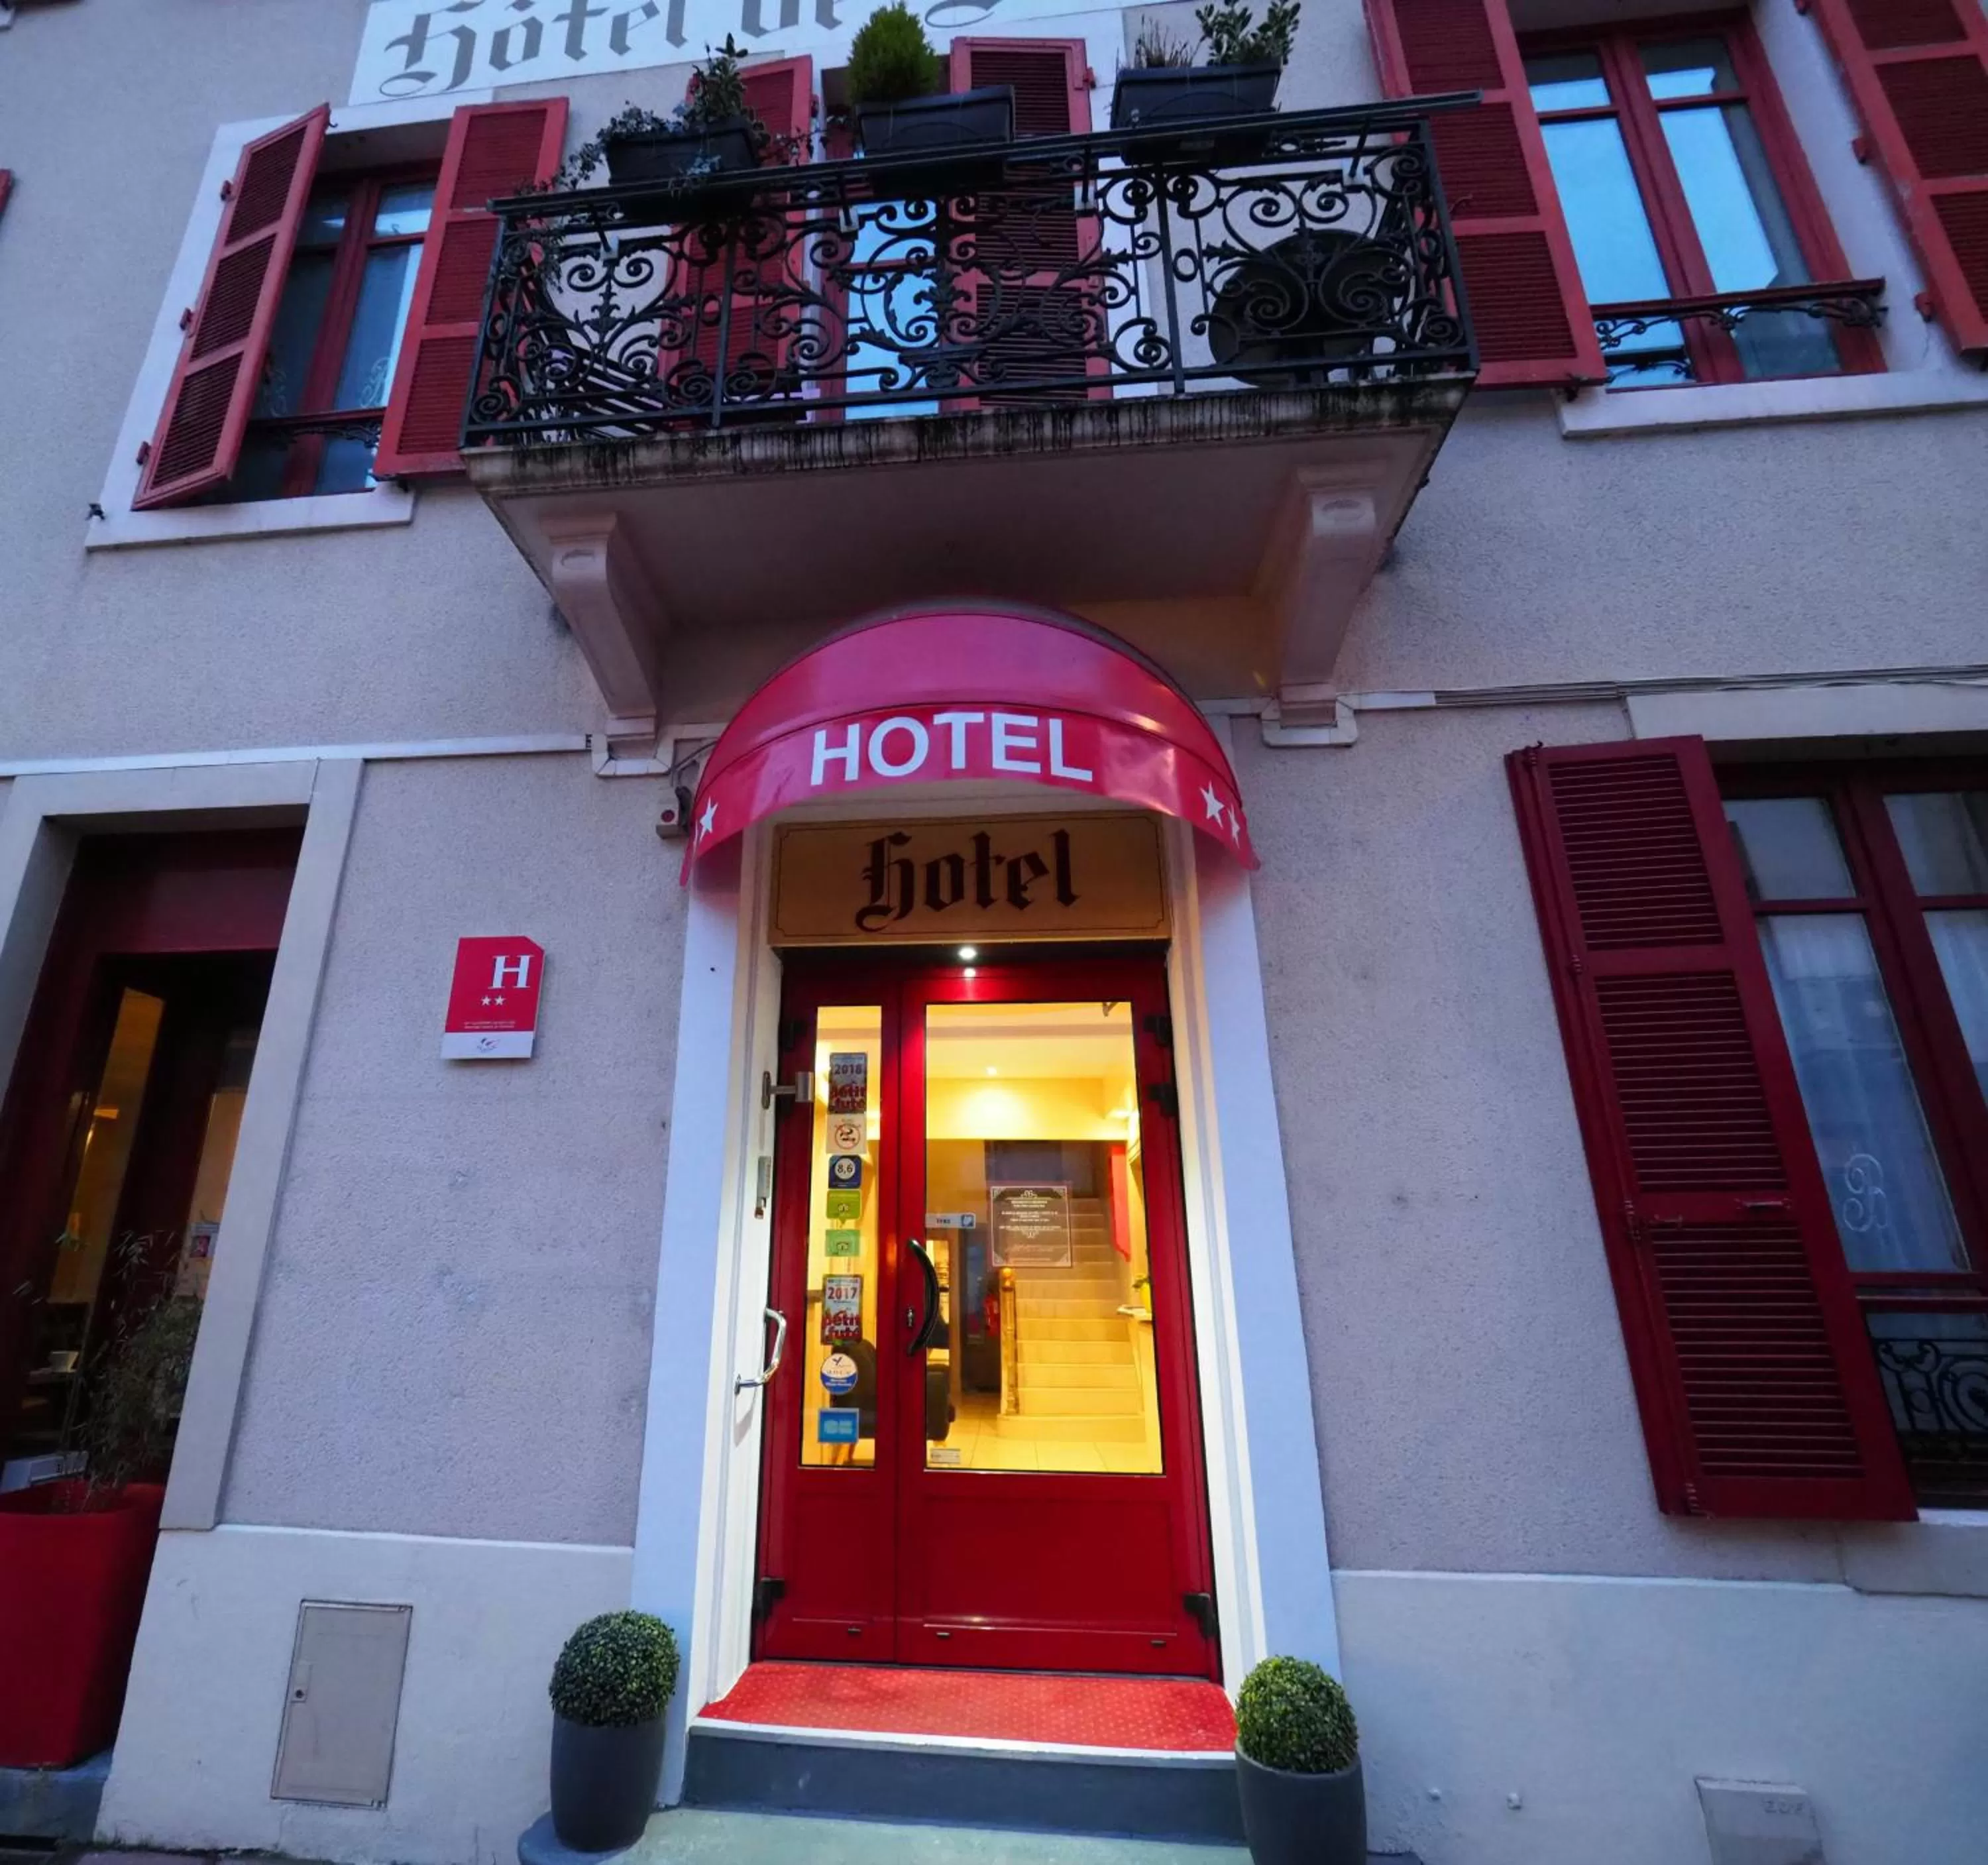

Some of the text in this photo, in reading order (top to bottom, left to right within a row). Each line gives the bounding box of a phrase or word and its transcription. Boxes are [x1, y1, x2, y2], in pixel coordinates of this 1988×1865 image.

[810, 711, 1093, 787] HOTEL
[488, 954, 535, 989] H
[837, 1163, 854, 1174] 8,6
[827, 1286, 857, 1300] 2017
